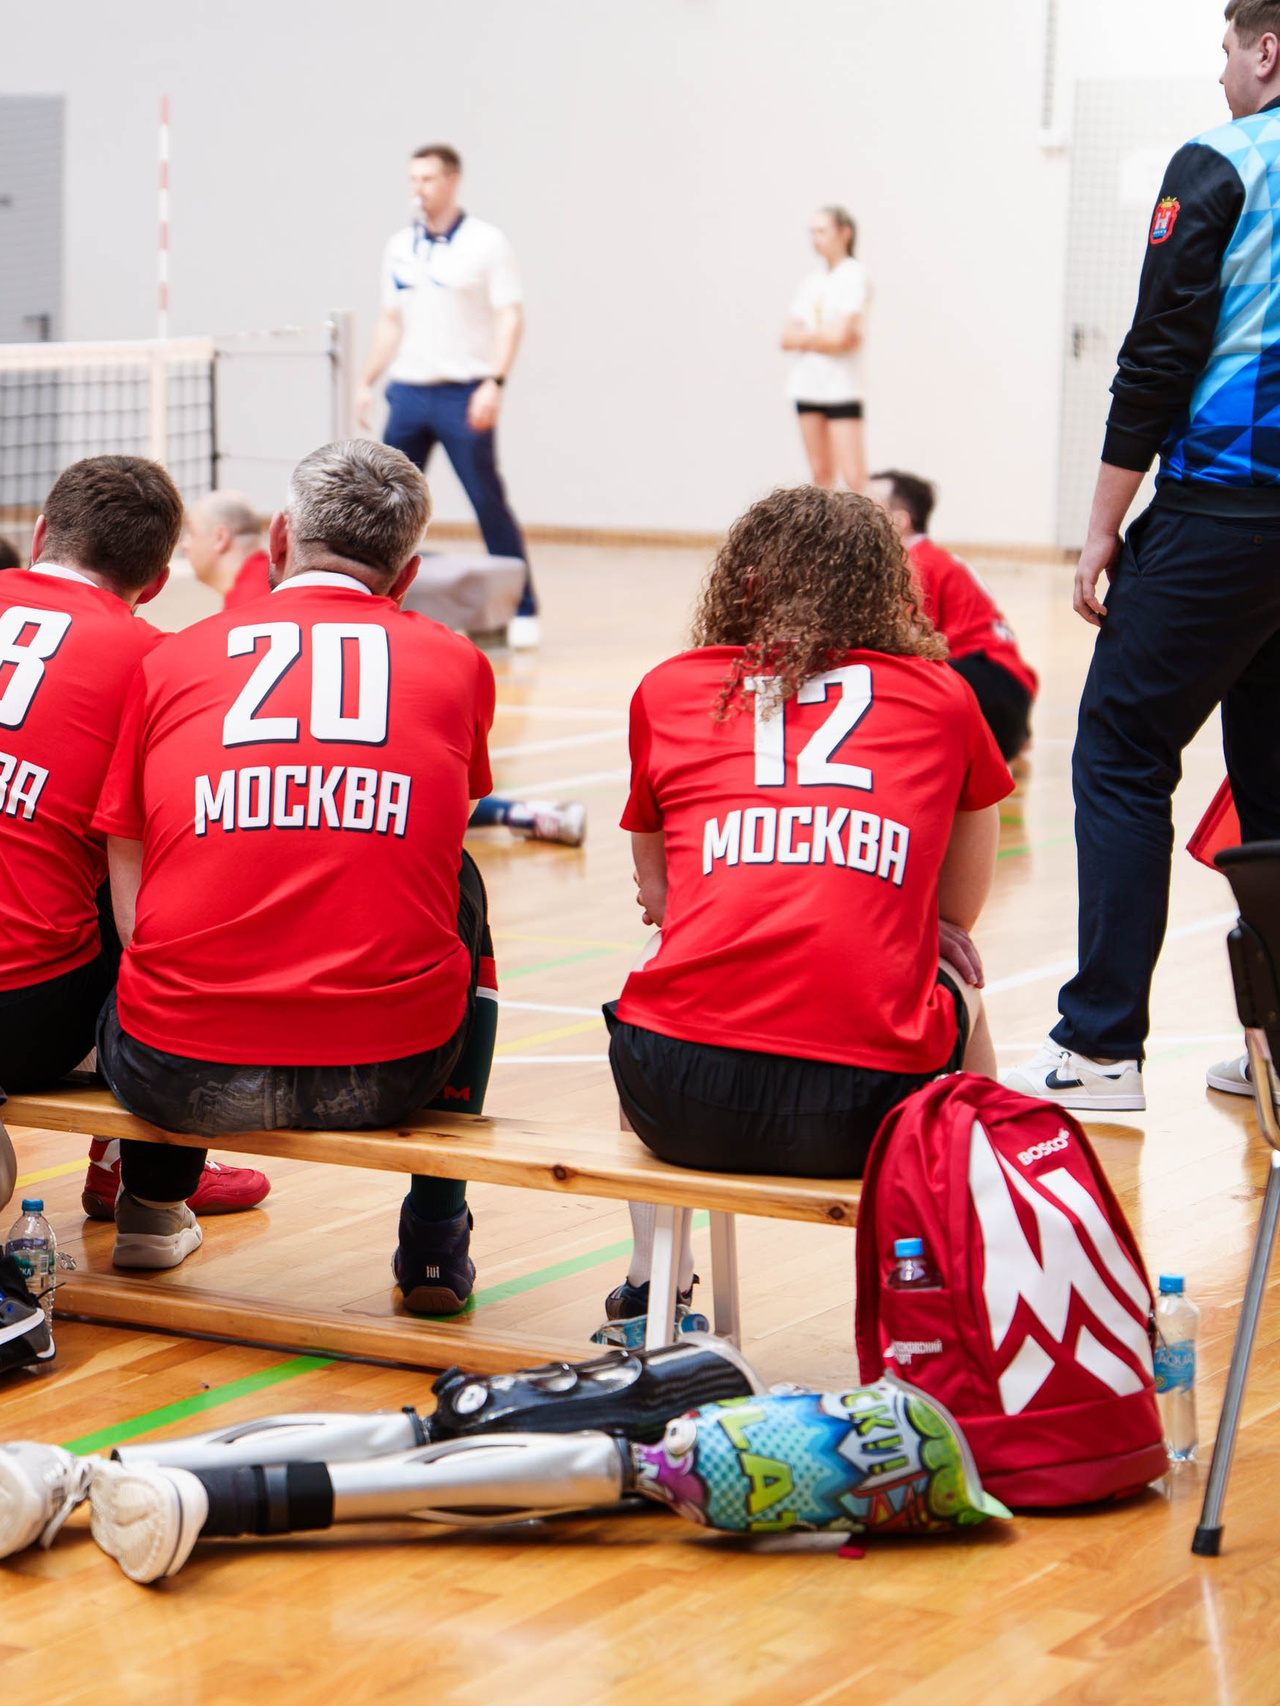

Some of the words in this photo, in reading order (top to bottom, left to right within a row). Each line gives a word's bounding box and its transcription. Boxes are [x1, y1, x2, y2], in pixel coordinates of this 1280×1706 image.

[222, 621, 390, 747] 20
[743, 664, 873, 793] 12
[194, 765, 412, 838] МОСКВА
[702, 805, 911, 888] МОСКВА
[1017, 1136, 1069, 1167] BOSCO
